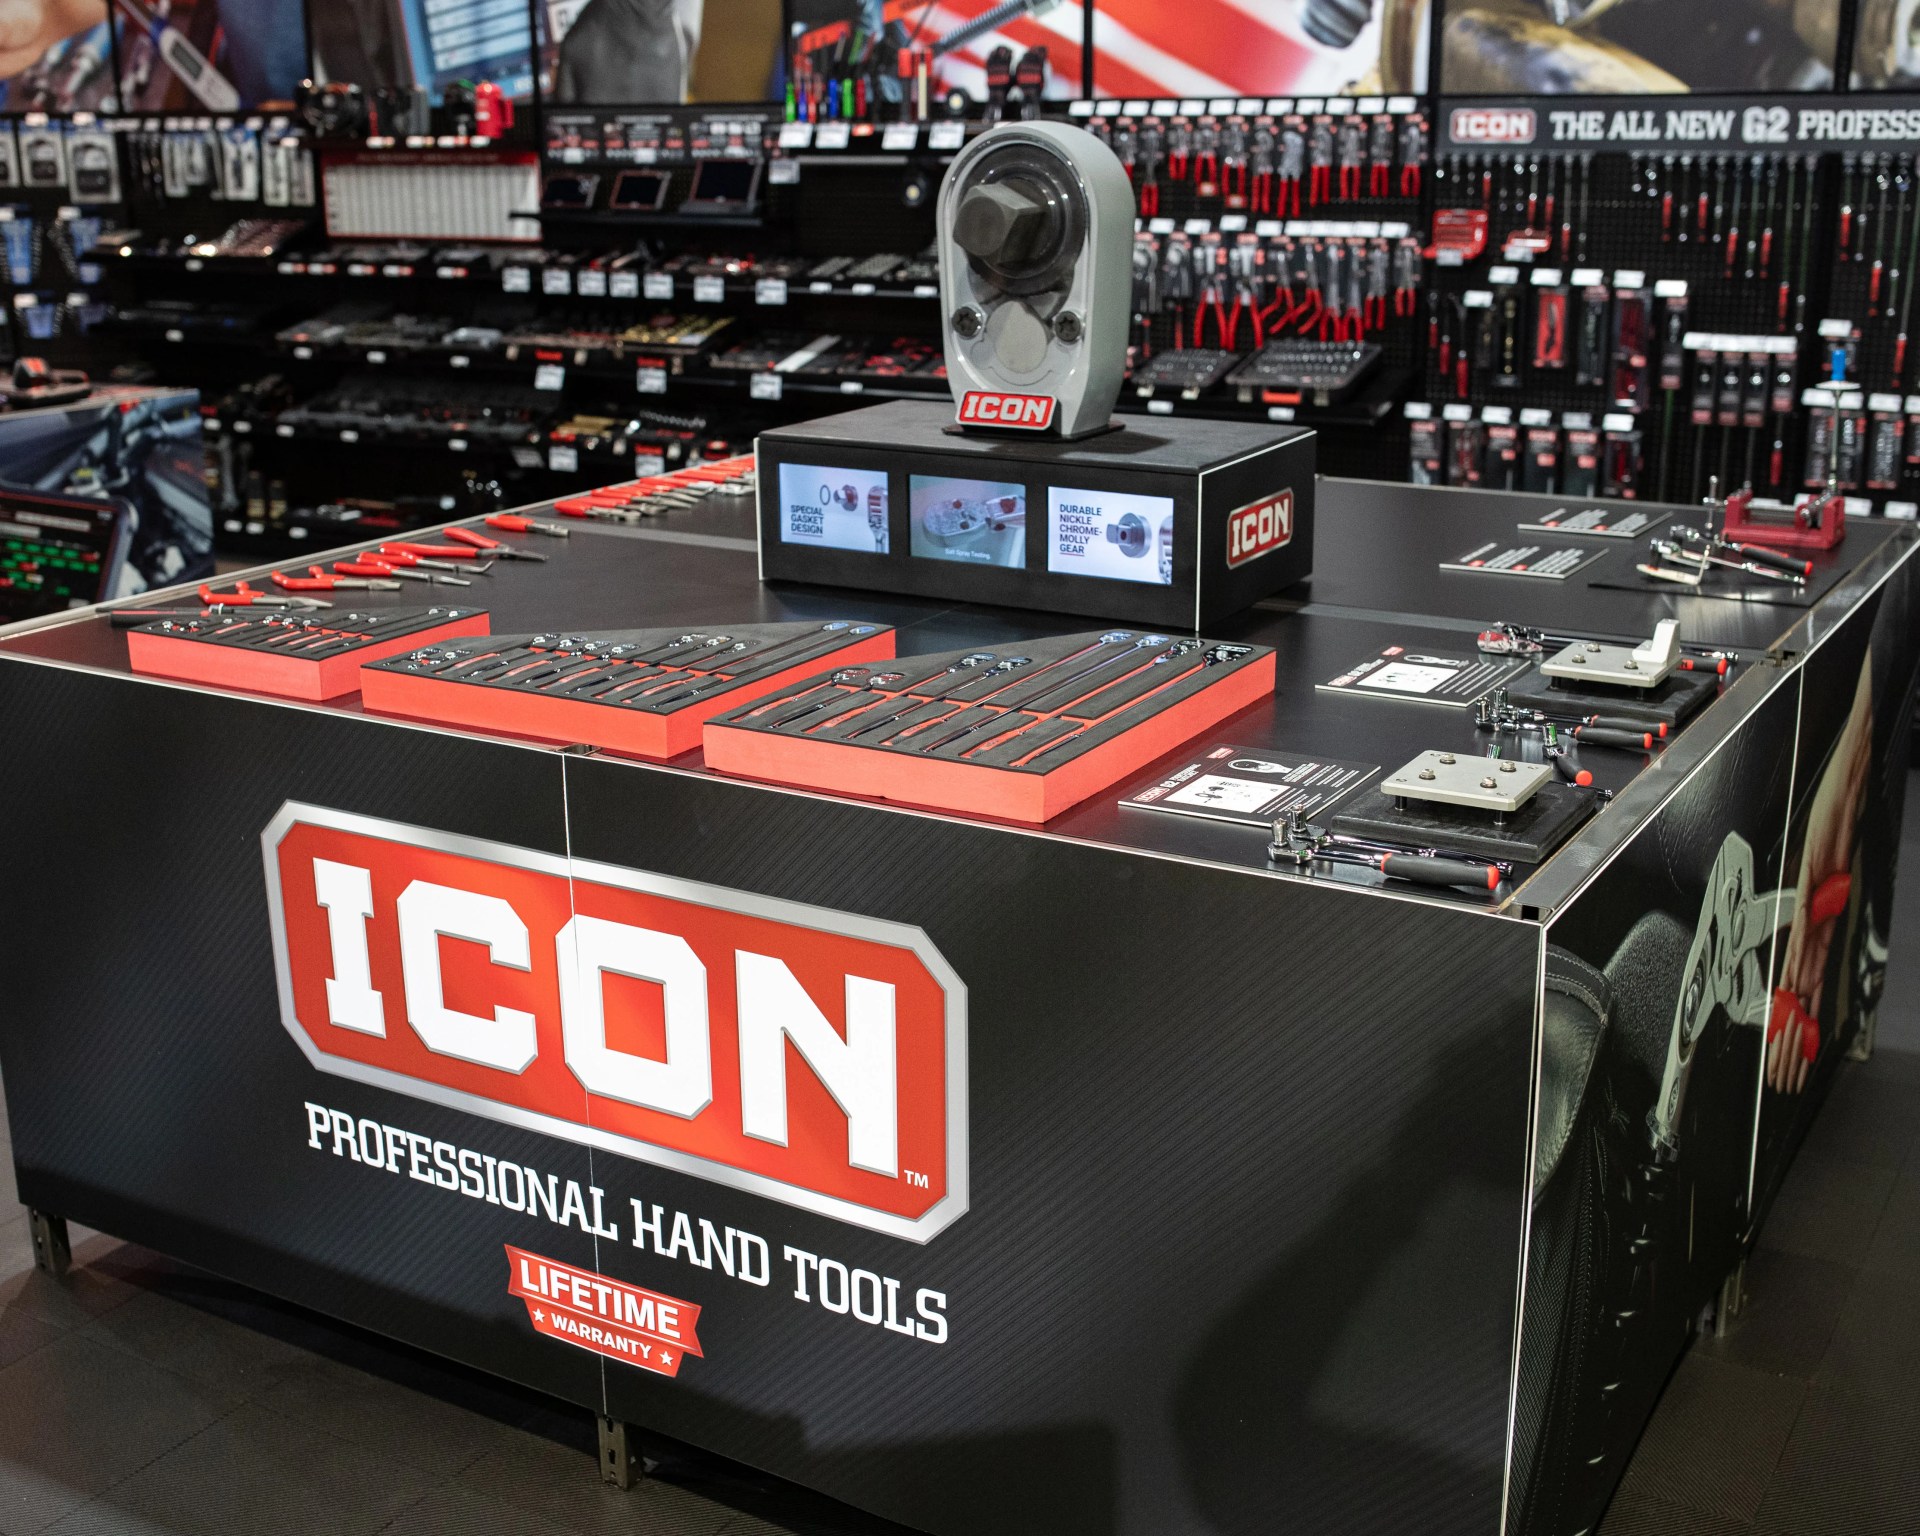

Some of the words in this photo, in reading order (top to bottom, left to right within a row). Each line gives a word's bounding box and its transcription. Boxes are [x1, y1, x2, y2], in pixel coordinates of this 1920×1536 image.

[1455, 113, 1530, 139] ICON
[1550, 111, 1604, 140] THE
[1608, 111, 1659, 140] ALL
[1665, 111, 1735, 140] NEW
[1742, 106, 1790, 143] G2
[964, 395, 1048, 423] ICON
[790, 504, 824, 515] SPECIAL
[1059, 503, 1102, 516] DURABLE
[790, 514, 824, 525] GASKET
[790, 523, 823, 534] DESIGN
[1059, 514, 1092, 525] NICKLE
[1231, 498, 1289, 557] ICON
[1059, 524, 1103, 535] CHROME-
[1059, 534, 1090, 545] MOLLY
[1059, 544, 1084, 554] GEAR
[312, 857, 898, 1179] ICON
[904, 1169, 930, 1190] TM
[304, 1102, 619, 1242] PROFESSIONAL
[629, 1198, 771, 1288] HAND
[784, 1245, 949, 1344] TOOLS
[519, 1258, 681, 1340] LIFETIME
[551, 1312, 653, 1361] WARRANTY
